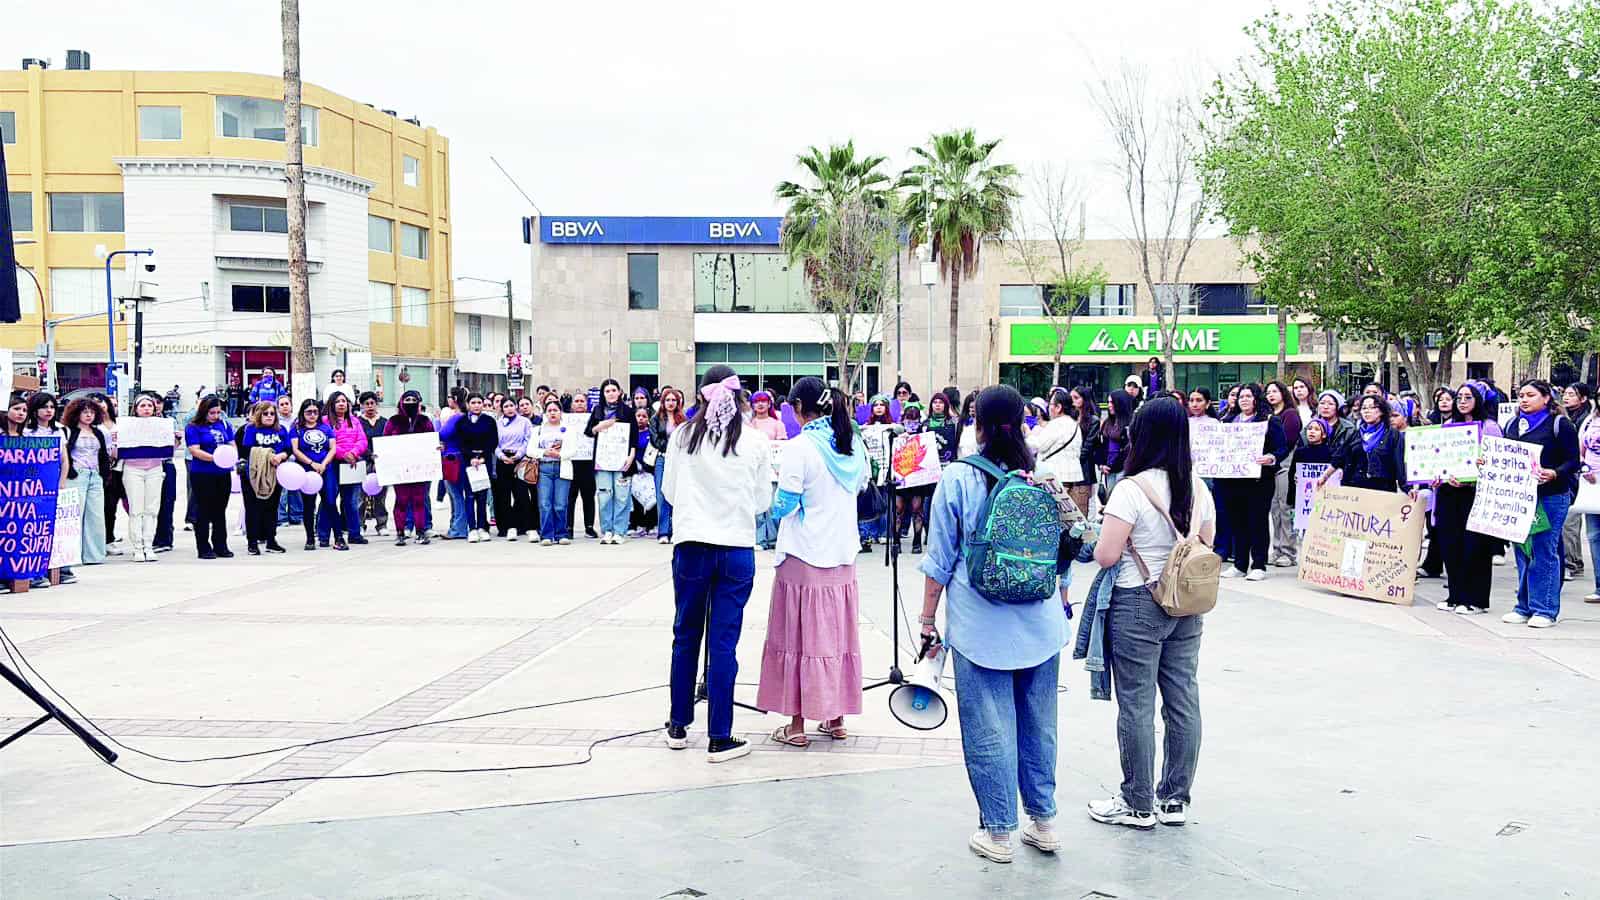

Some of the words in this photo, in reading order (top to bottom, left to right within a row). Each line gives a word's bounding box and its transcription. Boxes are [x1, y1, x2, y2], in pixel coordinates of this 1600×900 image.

[551, 221, 604, 237] BBVA
[709, 222, 761, 238] BBVA
[148, 342, 215, 354] Santander
[1123, 329, 1220, 351] AFIRME
[37, 447, 59, 464] QUE
[1495, 486, 1534, 502] controla
[1494, 498, 1527, 514] humilla
[1336, 508, 1393, 538] PINTURA
[1492, 512, 1517, 526] pega
[23, 520, 51, 537] QUE
[1387, 585, 1405, 598] 8M
